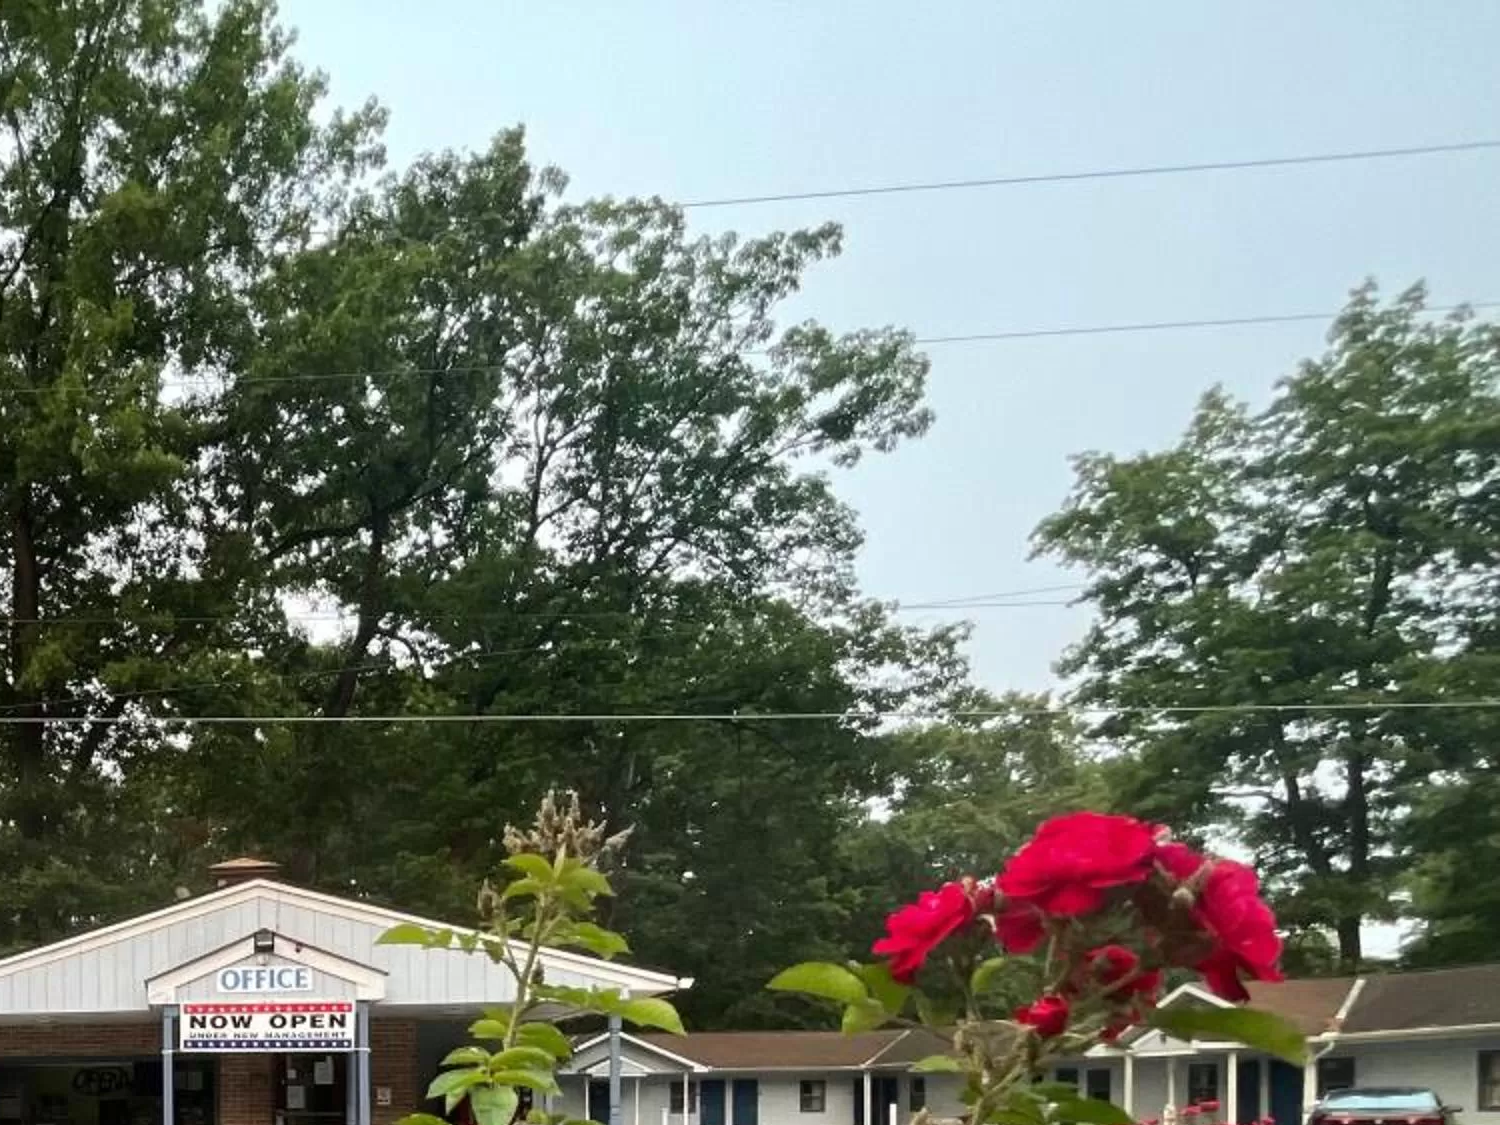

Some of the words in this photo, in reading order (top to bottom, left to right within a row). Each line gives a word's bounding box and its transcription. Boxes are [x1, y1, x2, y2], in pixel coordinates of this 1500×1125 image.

[221, 968, 308, 990] OFFICE
[190, 1015, 252, 1029] NOW
[269, 1014, 346, 1029] OPEN
[233, 1031, 259, 1039] NEW
[264, 1031, 346, 1039] MANAGEMENT
